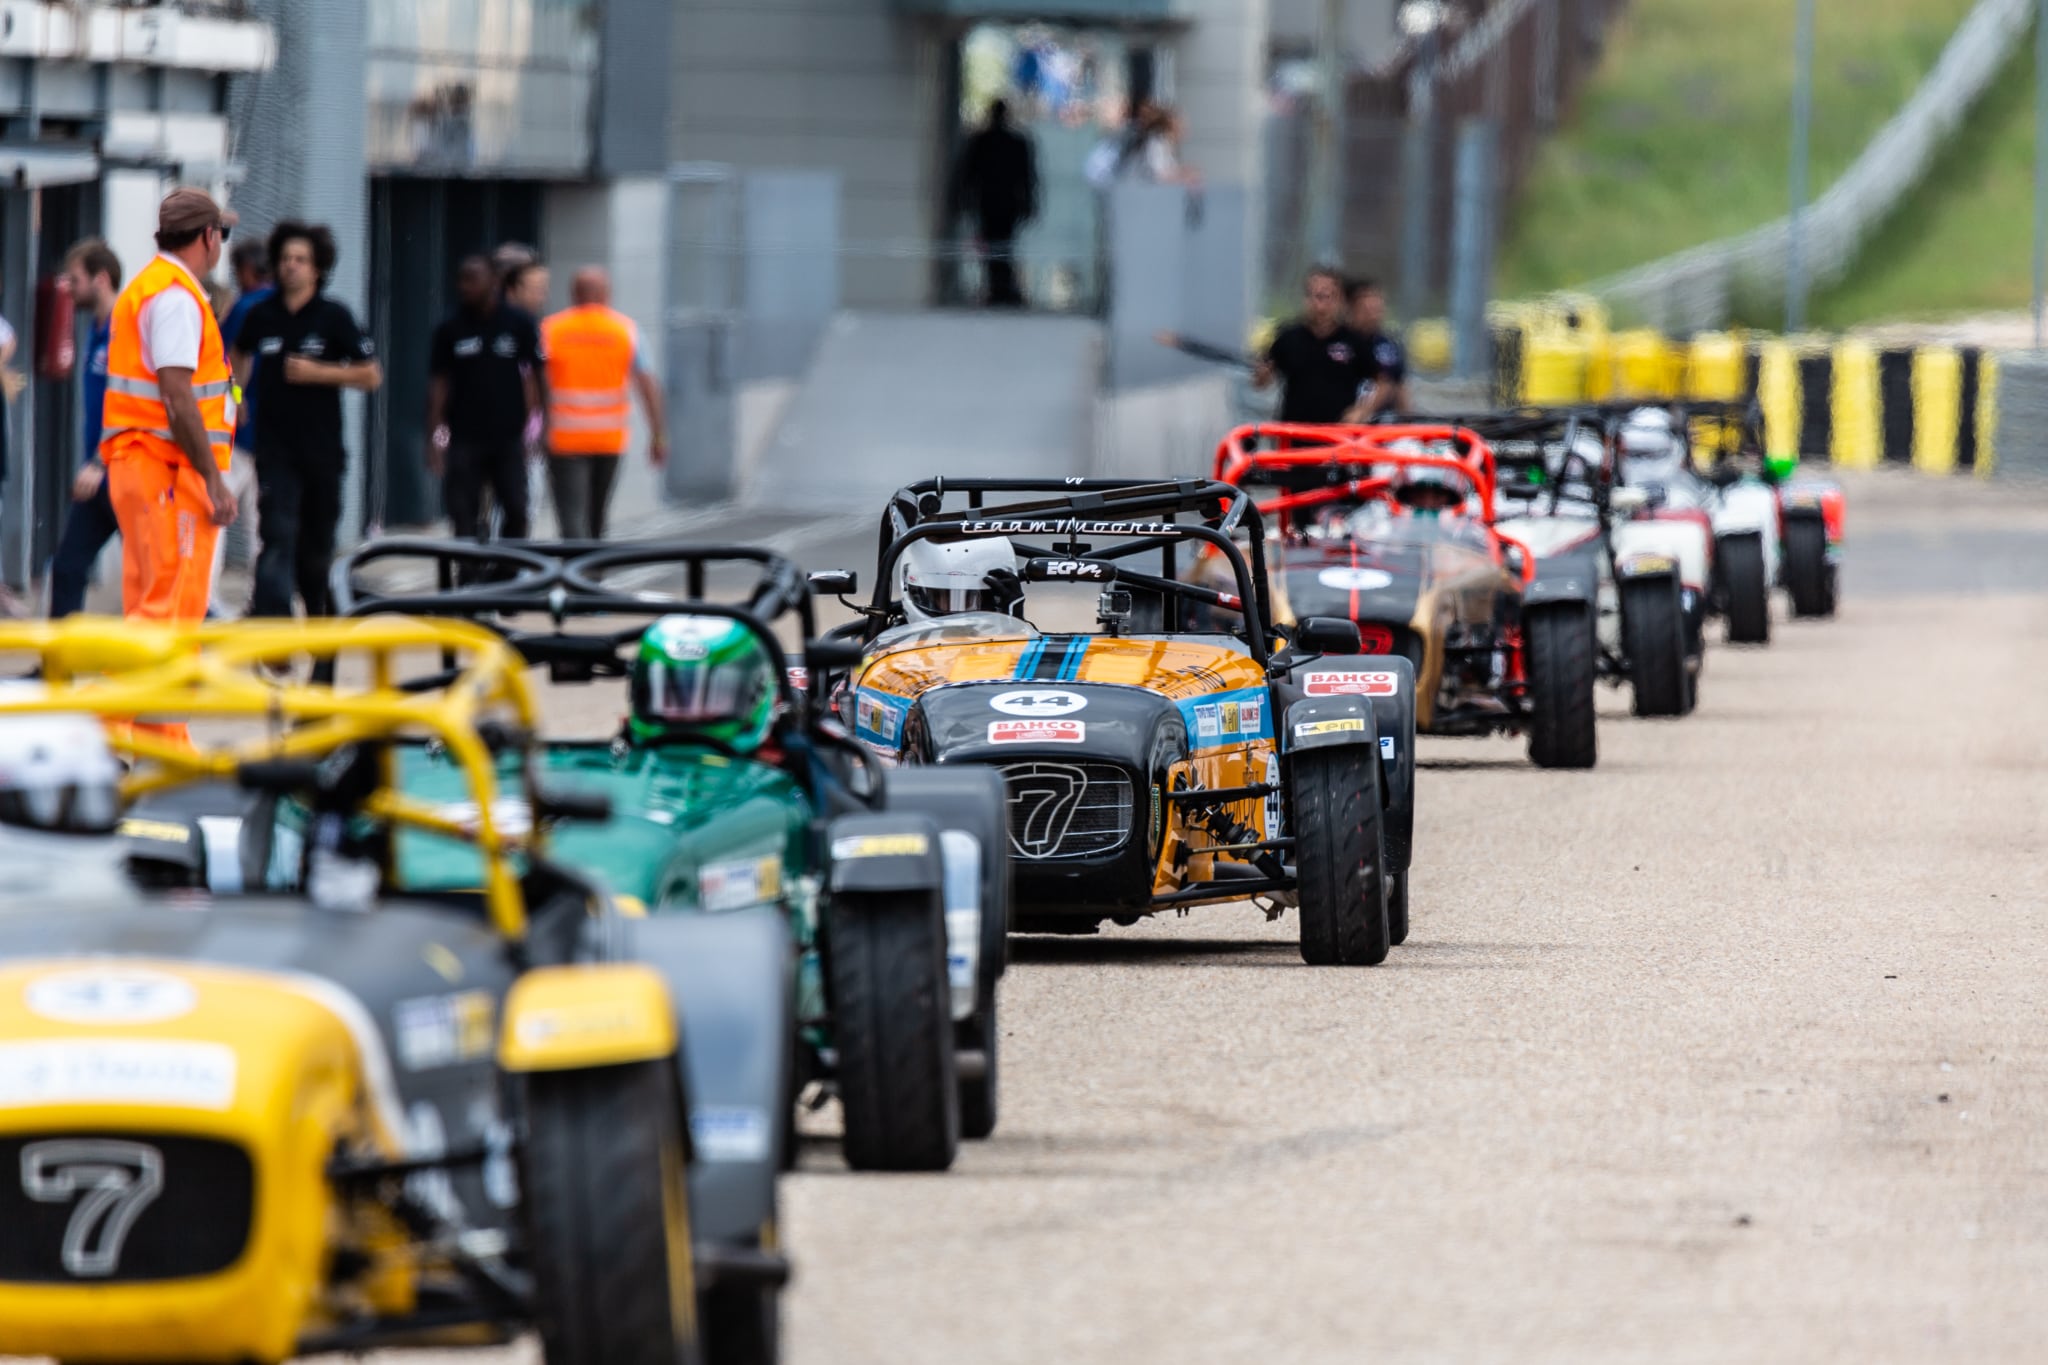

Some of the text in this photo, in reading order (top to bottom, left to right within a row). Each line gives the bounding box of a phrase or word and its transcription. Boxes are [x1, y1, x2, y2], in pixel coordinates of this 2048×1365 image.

[1311, 674, 1389, 682] BAHCO
[1004, 696, 1073, 706] 44
[996, 721, 1077, 730] BAHCO
[1325, 720, 1361, 731] eni
[1004, 770, 1077, 848] 7
[20, 1138, 164, 1278] 7
